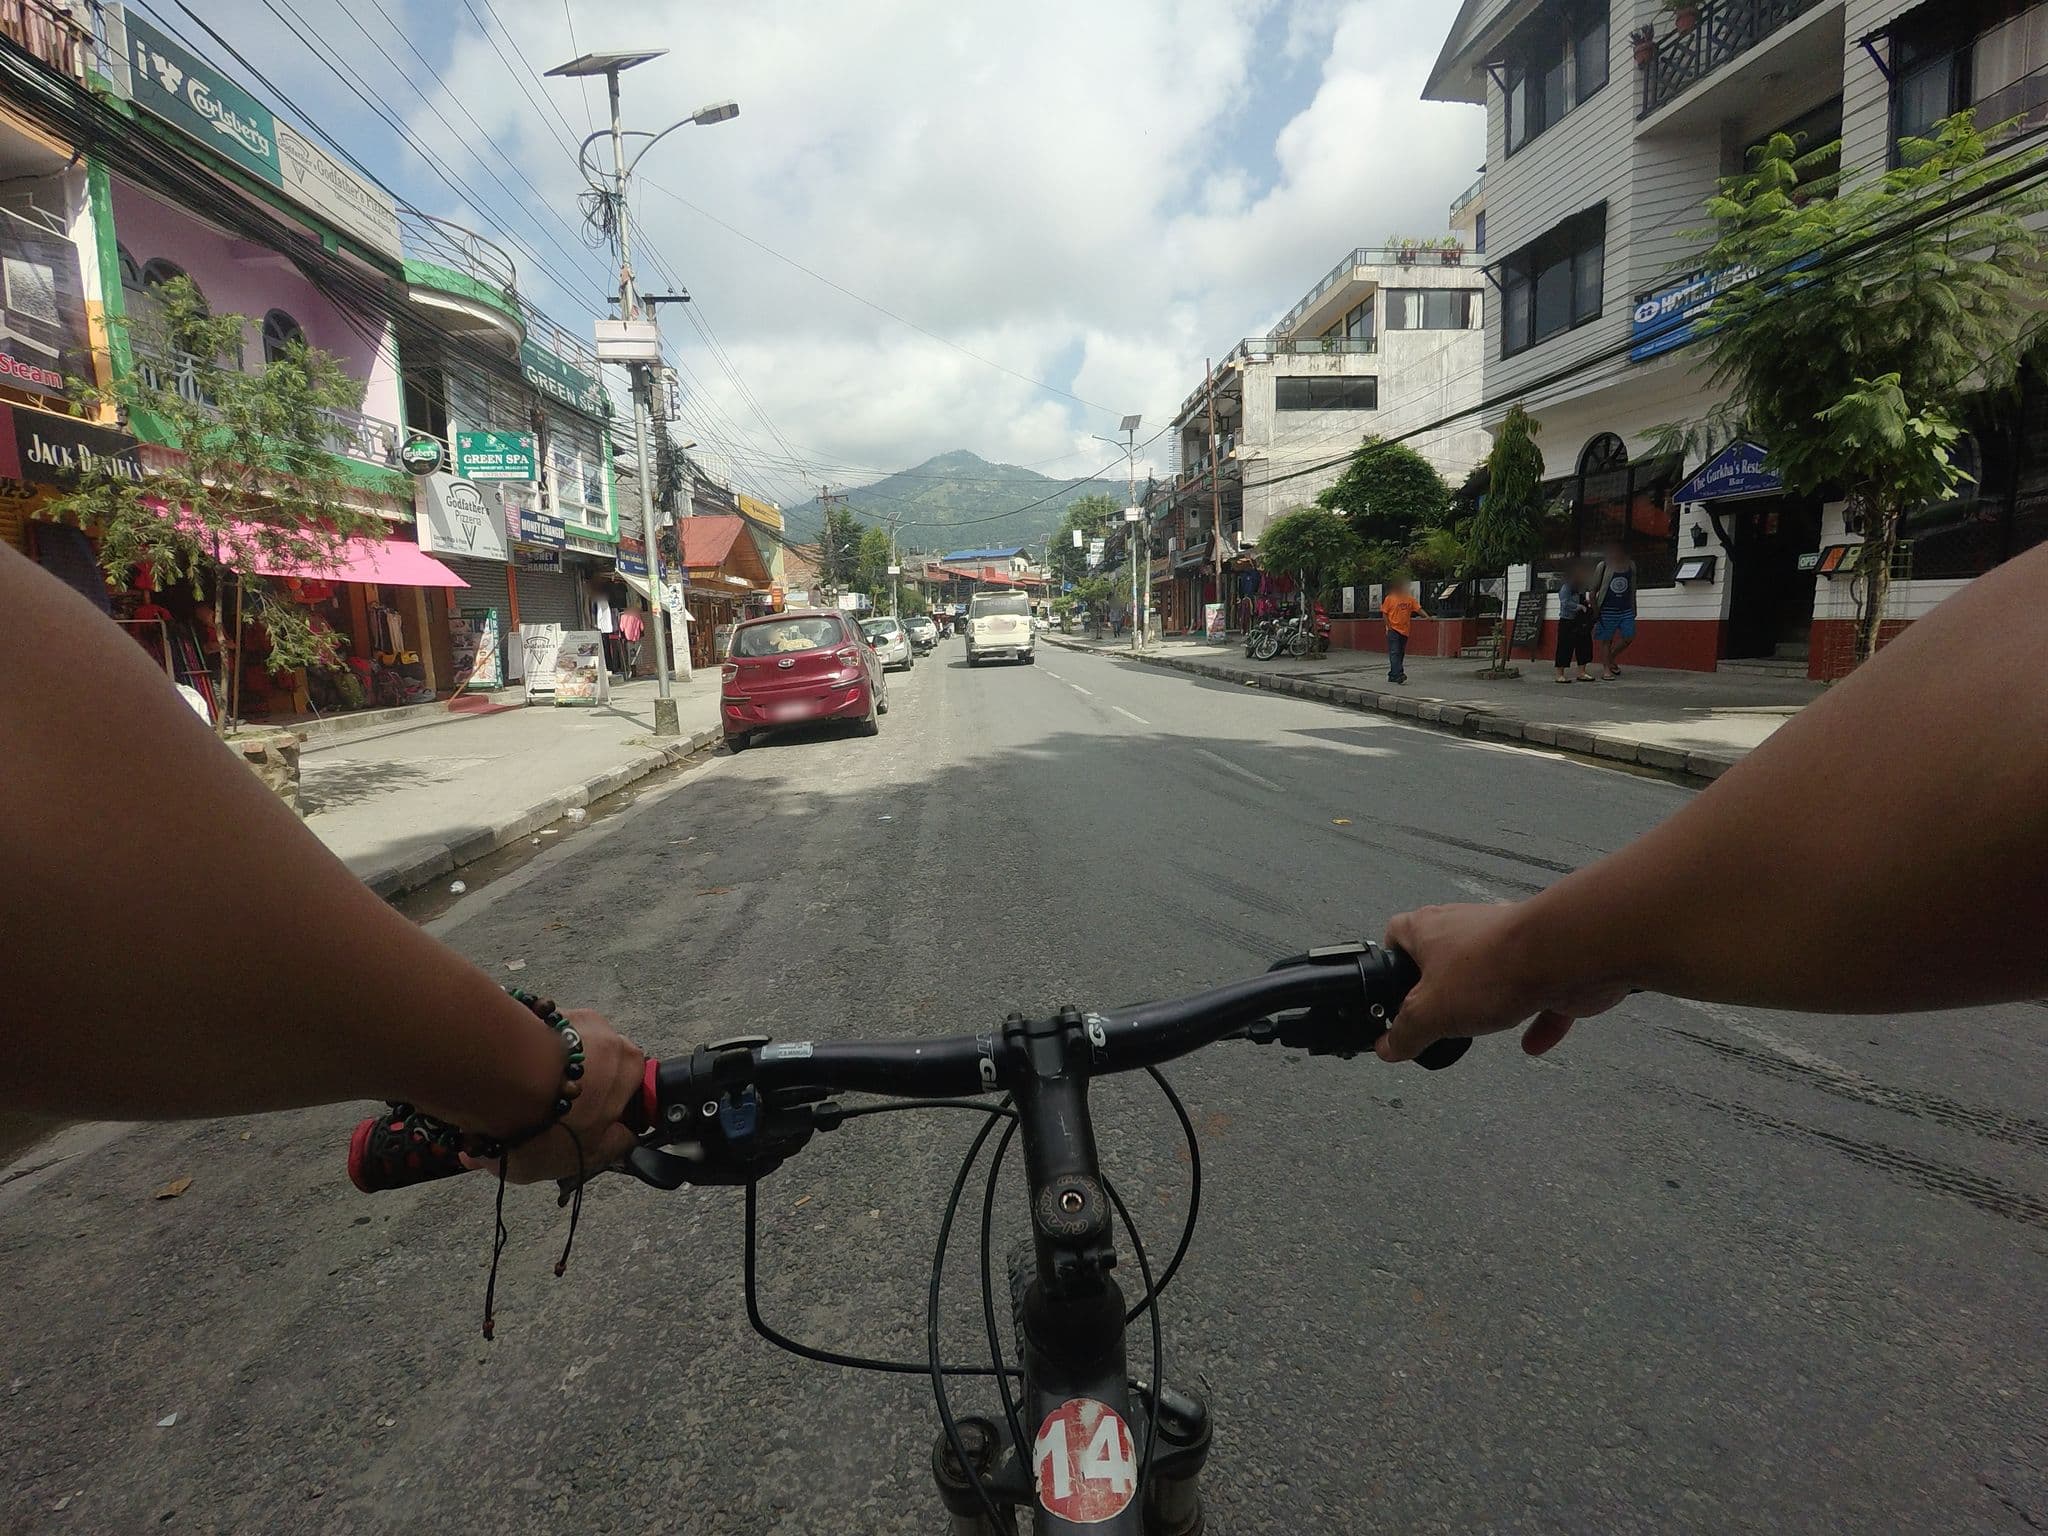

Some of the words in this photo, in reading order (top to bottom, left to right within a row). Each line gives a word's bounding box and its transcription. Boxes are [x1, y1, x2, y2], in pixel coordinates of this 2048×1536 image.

[187, 75, 270, 157] Carlsberg
[0, 352, 63, 389] Steam
[526, 364, 577, 406] GREEN
[28, 433, 75, 469] JACK
[402, 446, 438, 463] Carlsberg
[463, 454, 503, 464] GREEN
[505, 454, 530, 464] SPA
[1693, 477, 1706, 493] The
[1706, 460, 1740, 484] Gurkha's
[1728, 478, 1745, 486] Bar
[446, 495, 490, 516] Godfather's
[455, 510, 482, 526] Pizzeria
[521, 518, 541, 535] MONEY
[541, 523, 565, 540] CHANGER
[1035, 1415, 1129, 1500] 14
